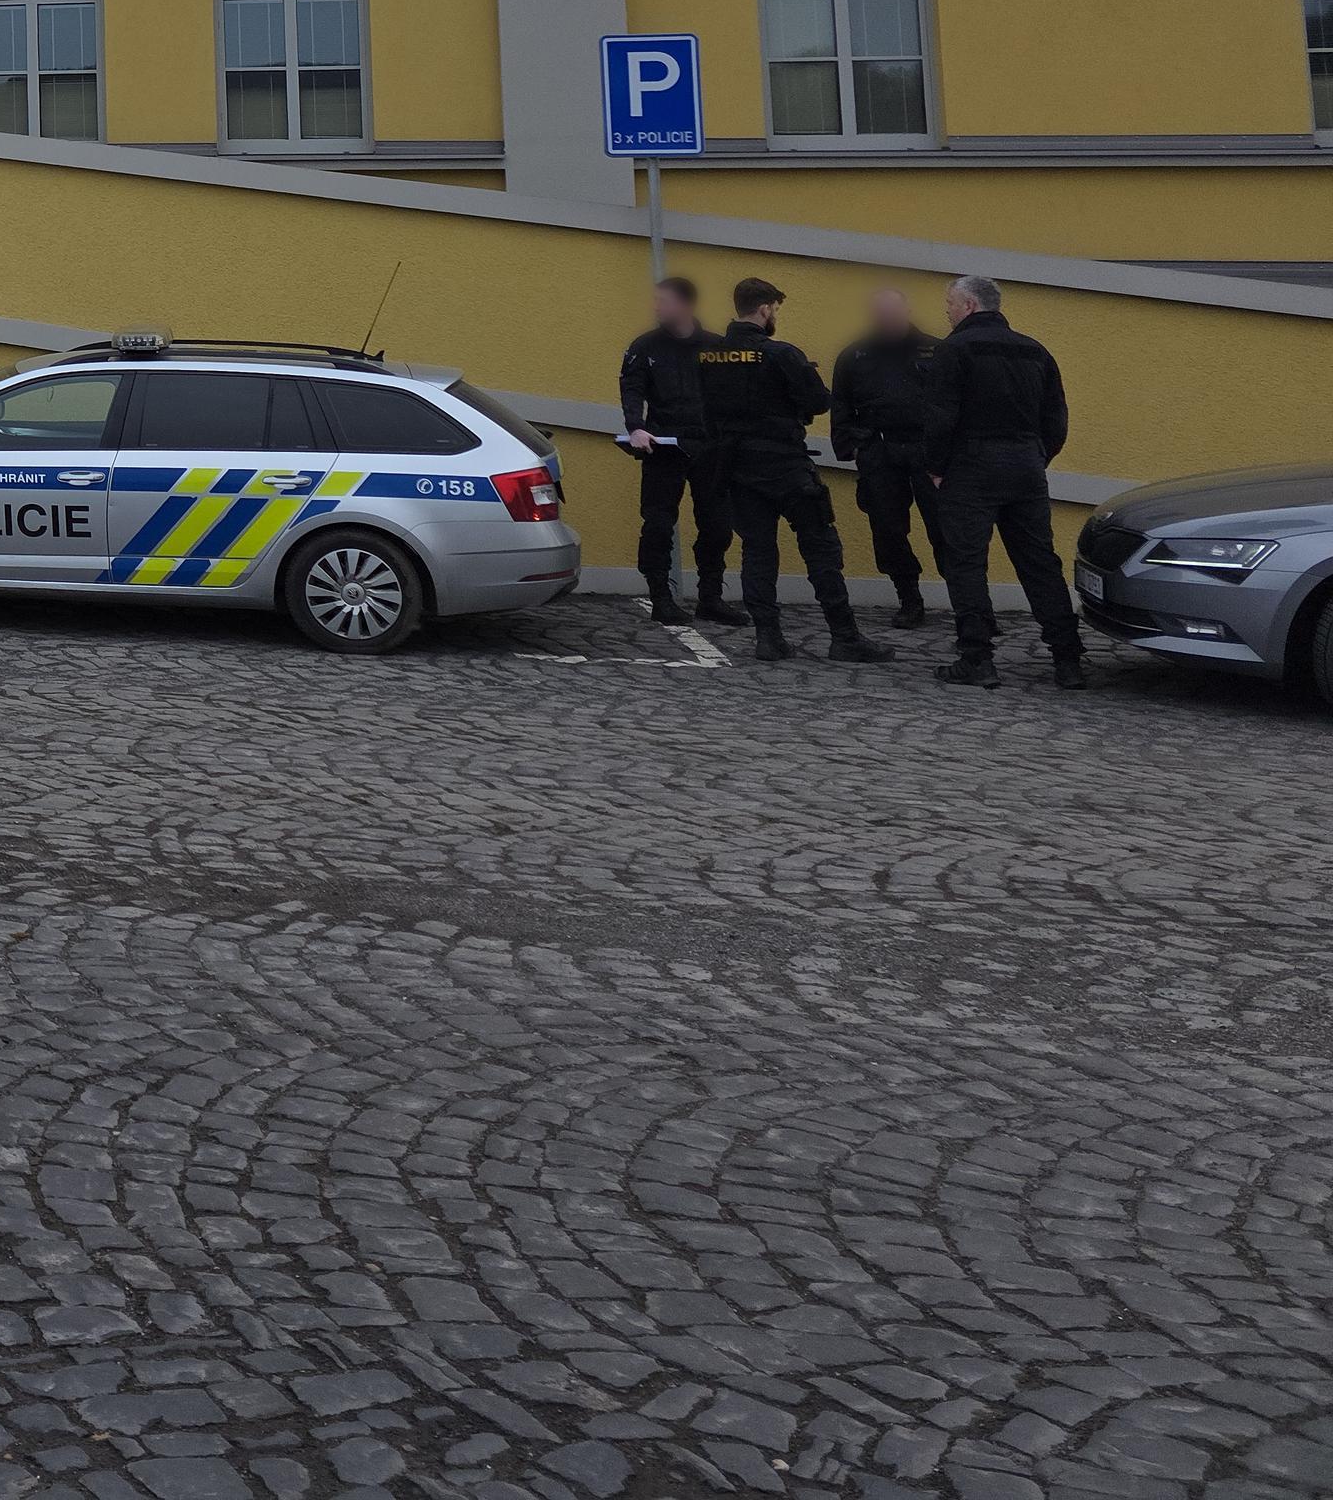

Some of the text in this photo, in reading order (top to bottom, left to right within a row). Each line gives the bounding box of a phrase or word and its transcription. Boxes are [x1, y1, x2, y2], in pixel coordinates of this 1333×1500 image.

[627, 51, 681, 117] P
[613, 131, 694, 144] 3 x POLICIE
[699, 351, 757, 364] POLICIE
[438, 480, 475, 496] 158
